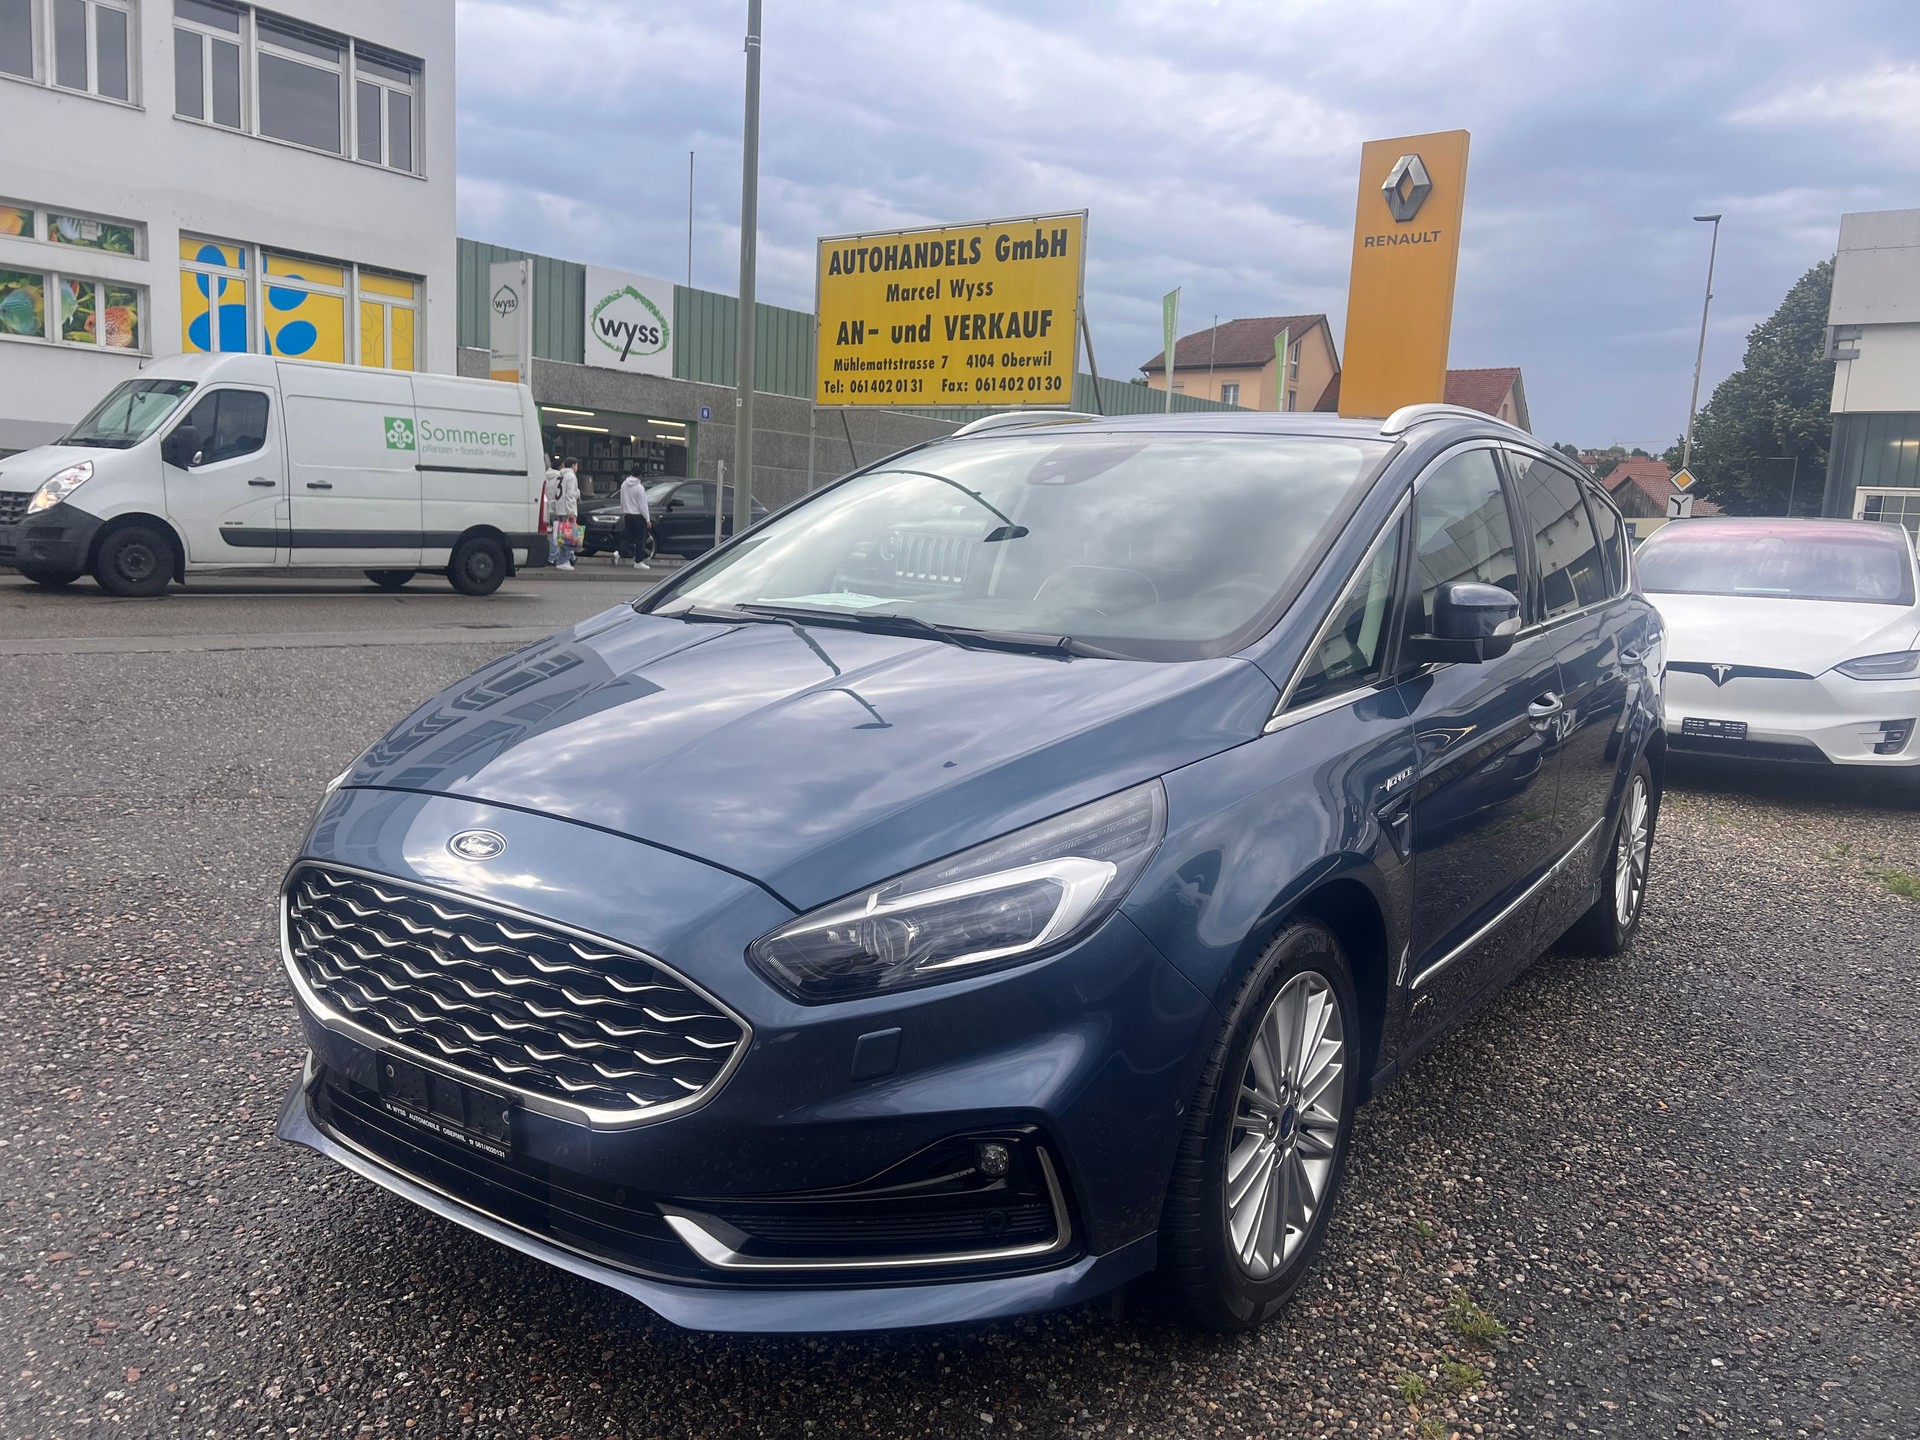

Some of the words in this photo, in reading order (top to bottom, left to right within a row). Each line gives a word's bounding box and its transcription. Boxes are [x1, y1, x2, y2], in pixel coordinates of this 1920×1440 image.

[1364, 230, 1441, 248] RENAULT
[828, 236, 982, 276] AUTOHANDELS
[995, 228, 1068, 263] GmbH
[886, 279, 941, 302] Marcel
[950, 278, 994, 302] Wyss
[495, 300, 515, 318] wyss
[599, 317, 659, 362] wyss
[836, 320, 879, 346] AN-
[891, 314, 931, 344] und
[944, 309, 1053, 342] VERKAUF
[834, 355, 935, 372] Mühlemattstrasse
[941, 356, 949, 369] 7
[966, 354, 995, 369] 4104
[1001, 351, 1052, 368] Oberwil
[824, 379, 844, 394] Tel:
[941, 378, 968, 393] Fax:
[420, 419, 515, 447] Sommerer
